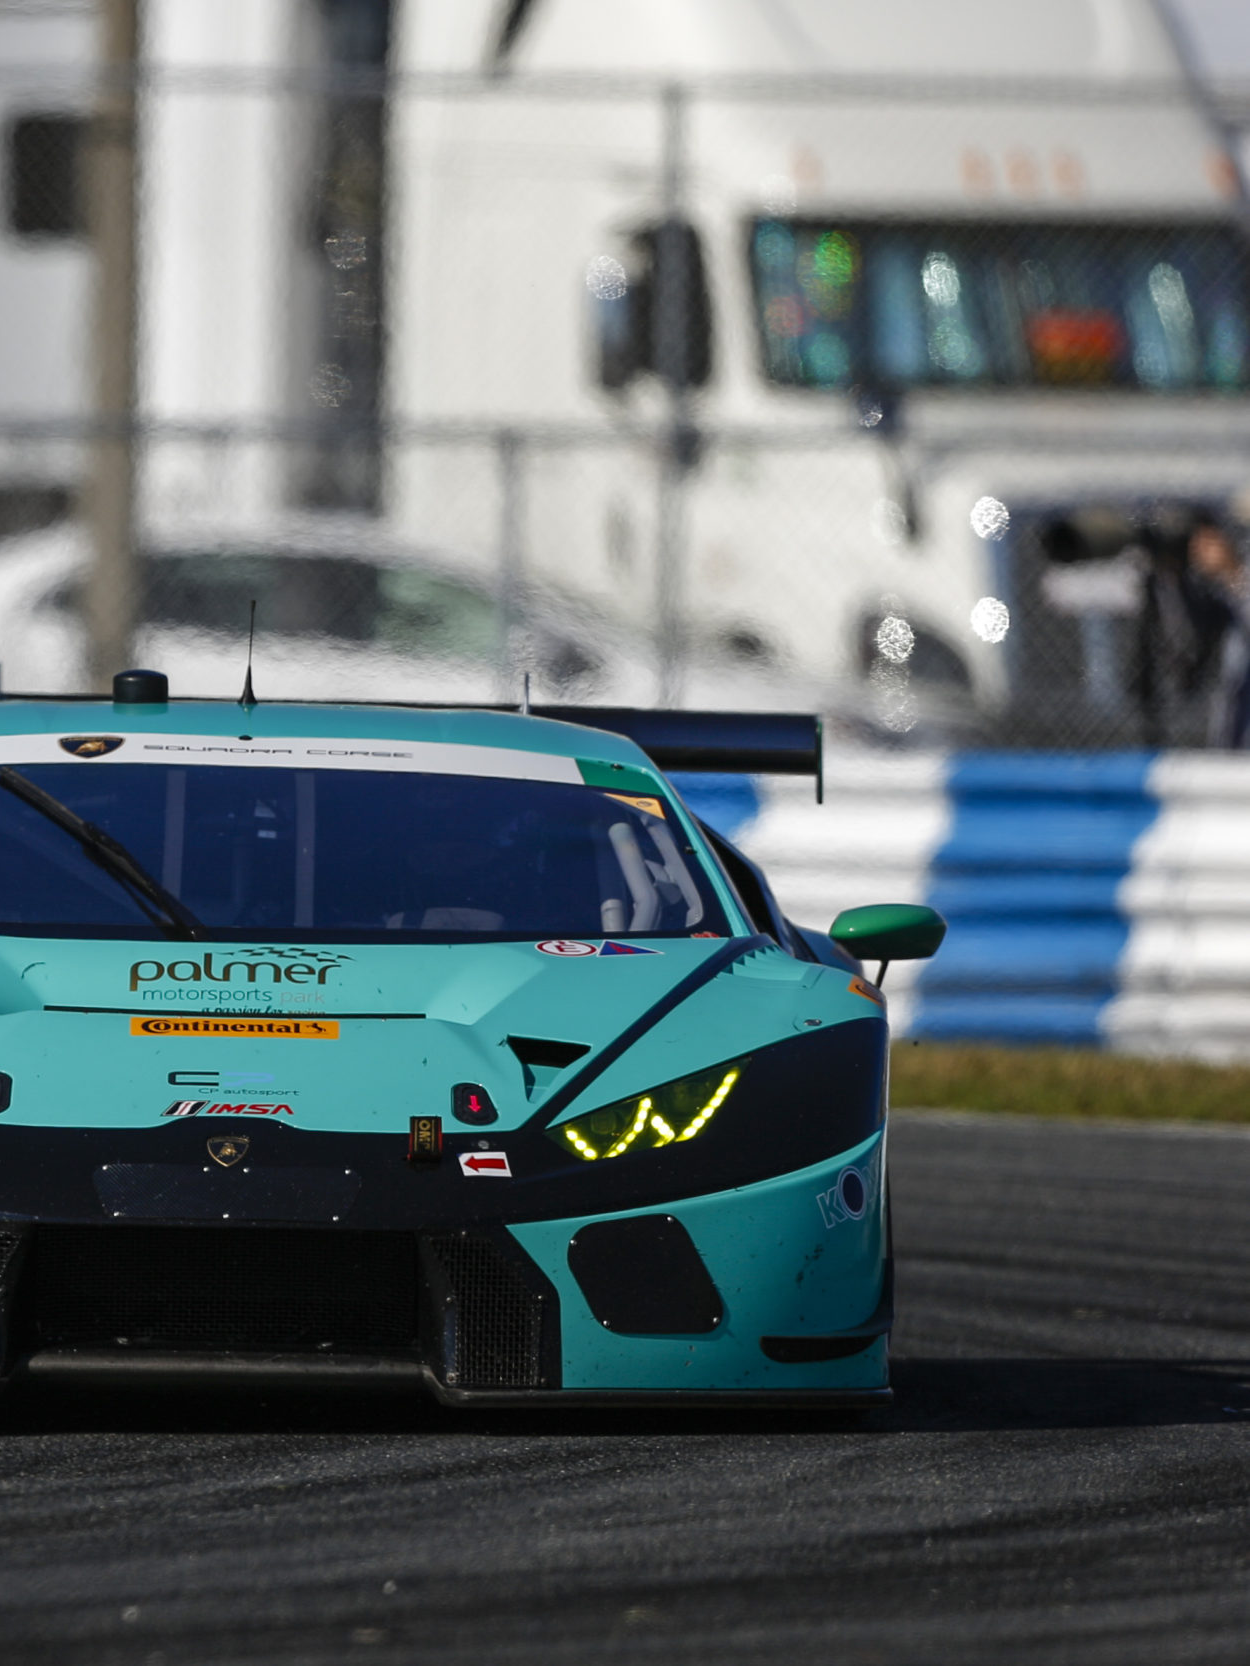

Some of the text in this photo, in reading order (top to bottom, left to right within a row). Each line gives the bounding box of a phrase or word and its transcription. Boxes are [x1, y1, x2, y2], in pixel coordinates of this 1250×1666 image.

[143, 744, 413, 759] SQUADRA CORSE
[129, 952, 342, 992] palmer
[142, 988, 325, 1005] motorsports park
[141, 1019, 301, 1034] Continental
[198, 1087, 300, 1097] CP autosport
[206, 1103, 294, 1115] IMSA
